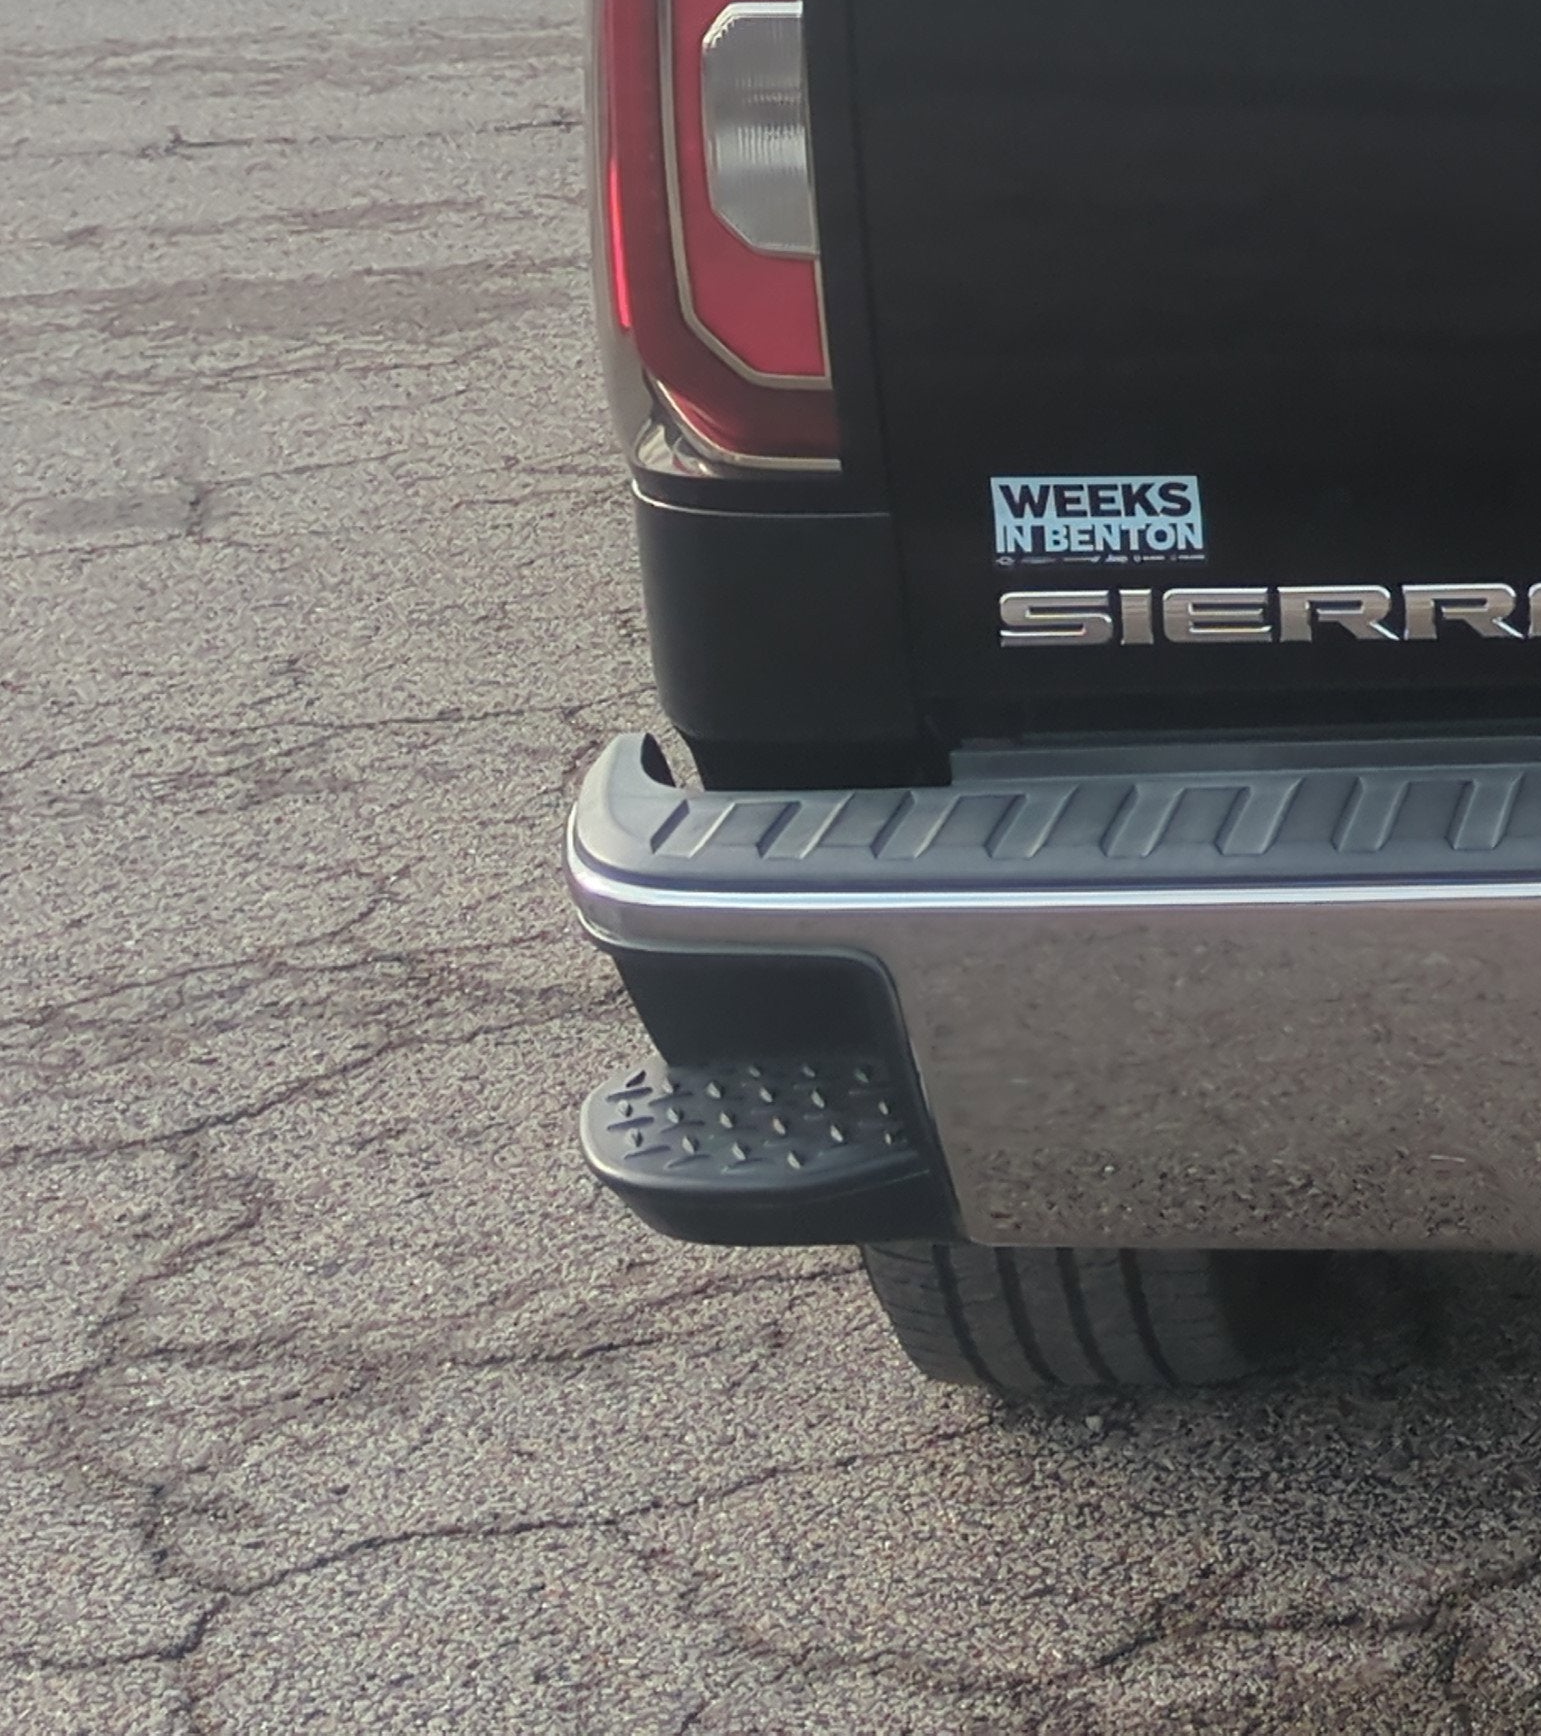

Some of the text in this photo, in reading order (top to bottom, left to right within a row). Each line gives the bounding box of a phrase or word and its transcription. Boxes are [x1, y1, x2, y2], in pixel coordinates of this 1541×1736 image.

[999, 482, 1192, 518] WEEKS
[996, 522, 1203, 553] IN BENTON
